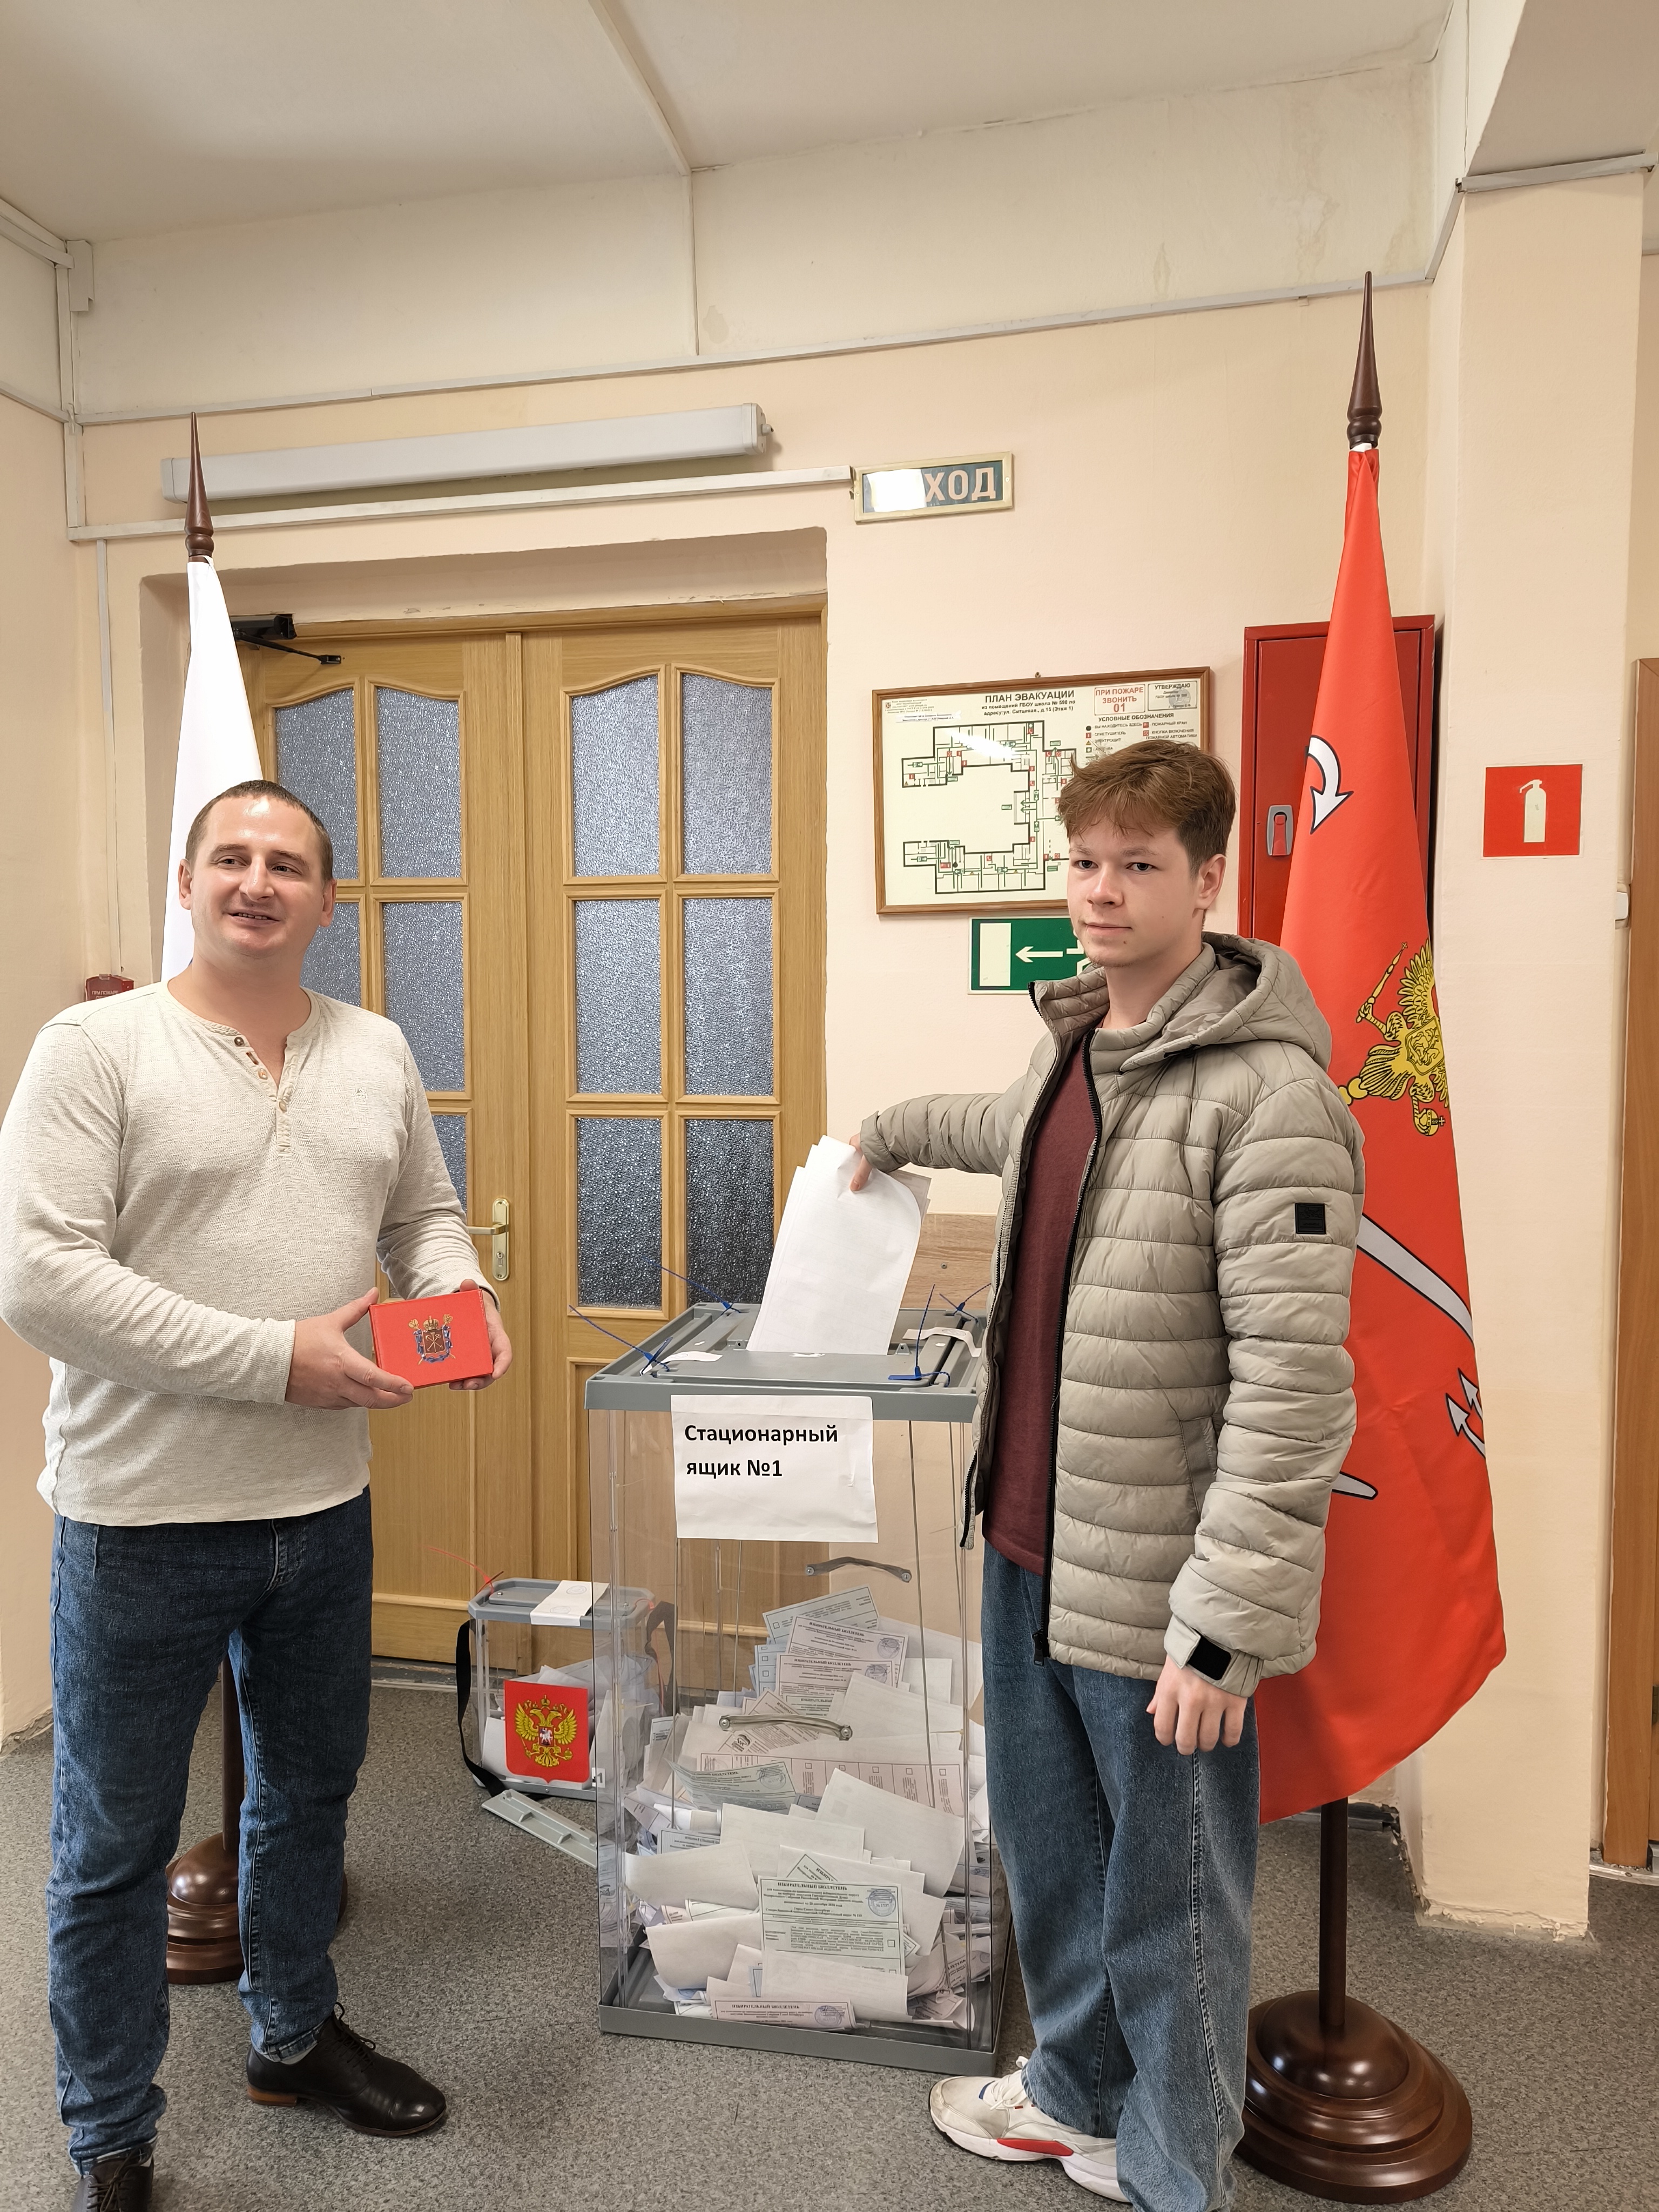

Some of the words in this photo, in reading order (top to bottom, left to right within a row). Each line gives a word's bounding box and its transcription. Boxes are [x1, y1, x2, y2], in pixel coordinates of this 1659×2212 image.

[985, 694, 1012, 703] ПЛАН
[1015, 690, 1075, 701] ЭВАКУАЦИИ
[1112, 687, 1144, 695] ПОЖАРЕ
[1113, 703, 1125, 712] 01
[685, 1425, 838, 1445] Стационарный
[686, 1462, 740, 1479] ящик
[747, 1460, 783, 1476] №1
